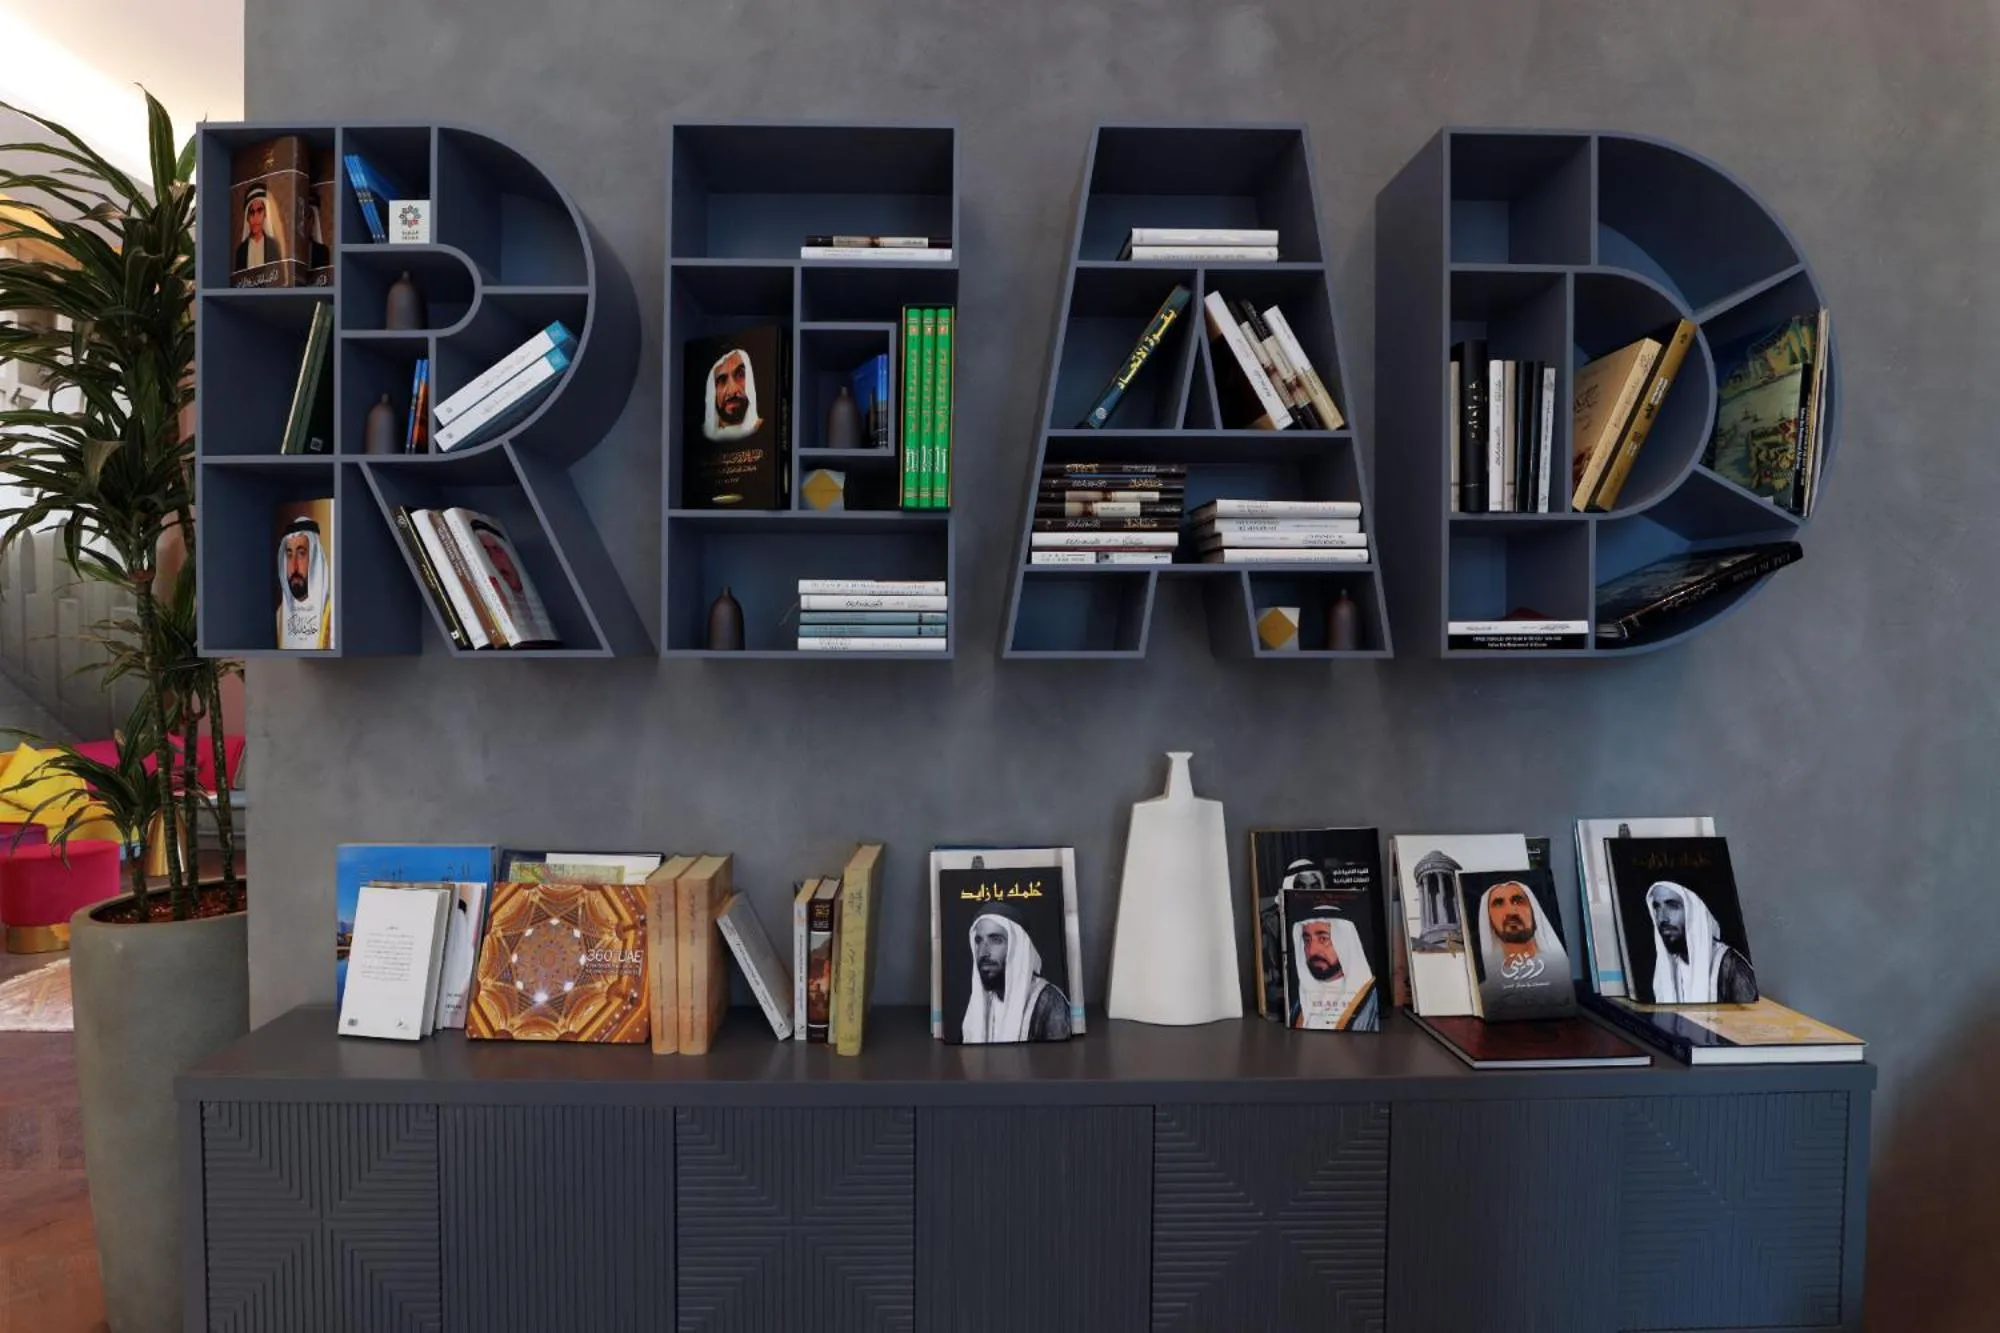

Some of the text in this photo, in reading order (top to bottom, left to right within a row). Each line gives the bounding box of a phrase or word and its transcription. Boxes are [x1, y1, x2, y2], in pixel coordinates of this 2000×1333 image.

[195, 121, 1830, 661] READ
[960, 883, 992, 902] زايد
[992, 882, 1004, 901] يا
[618, 949, 644, 963] UAE
